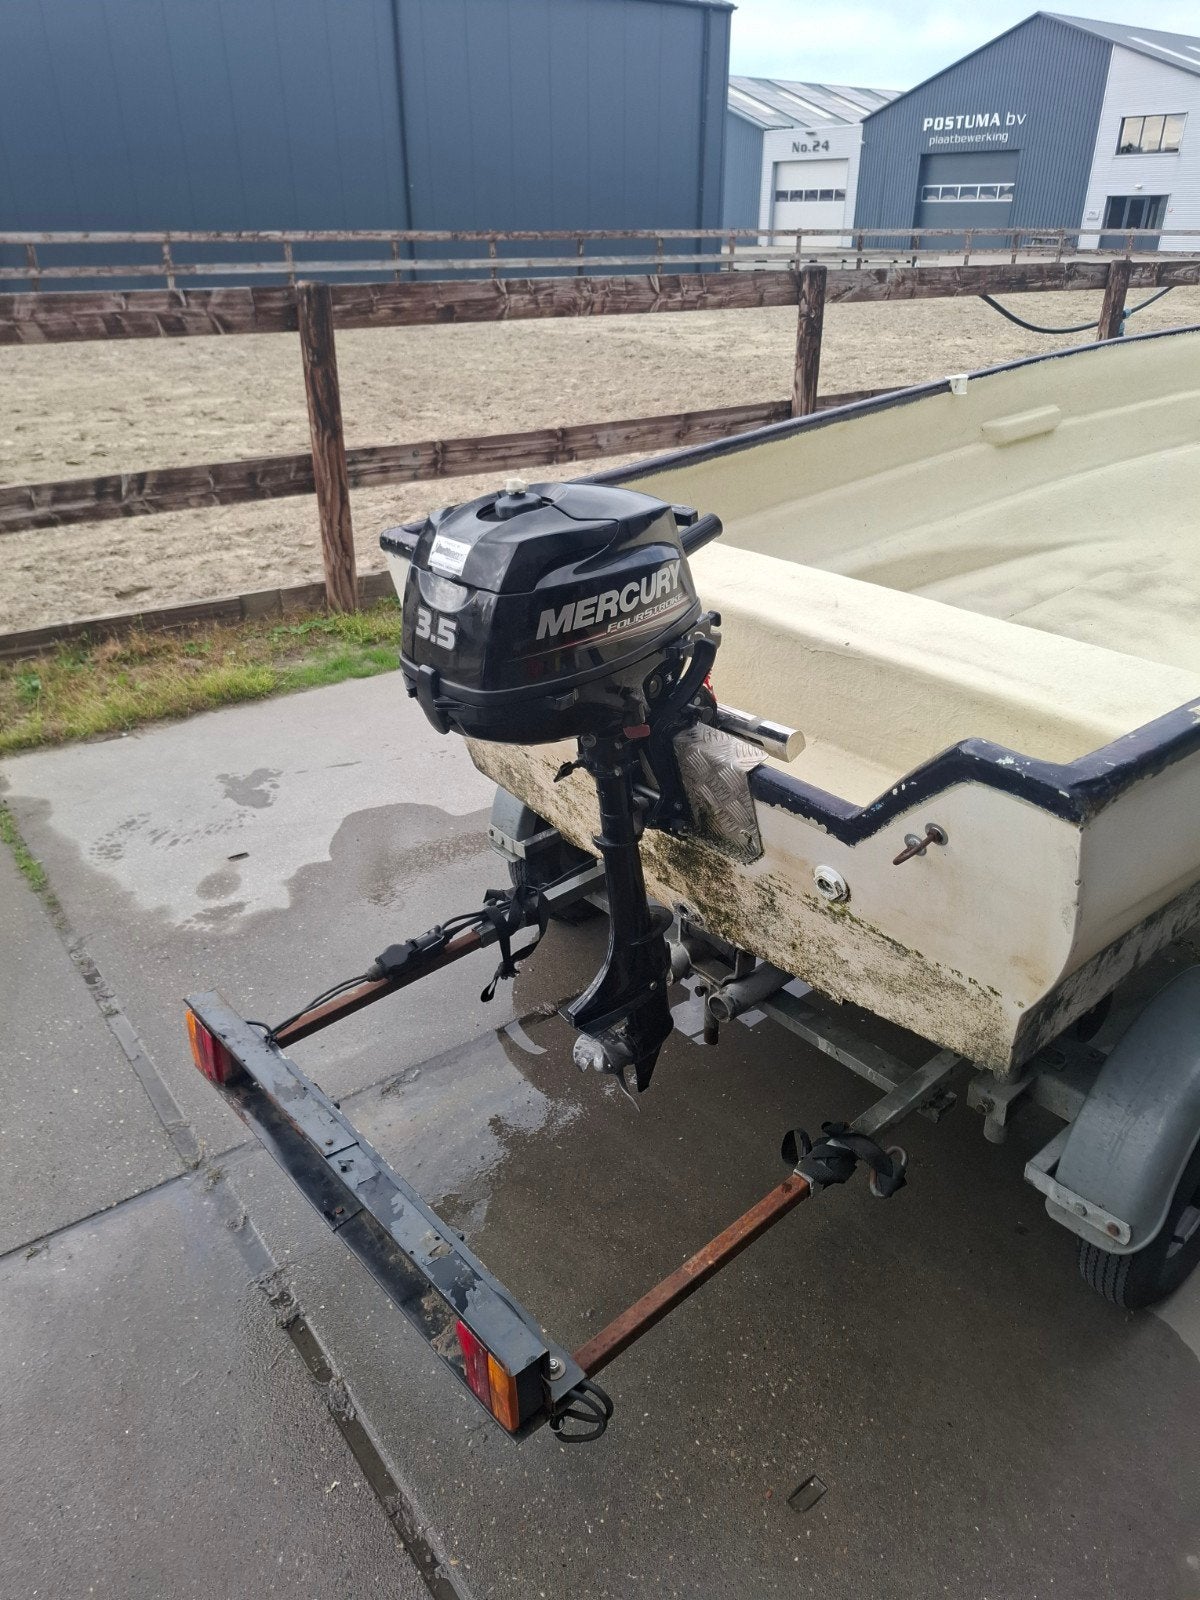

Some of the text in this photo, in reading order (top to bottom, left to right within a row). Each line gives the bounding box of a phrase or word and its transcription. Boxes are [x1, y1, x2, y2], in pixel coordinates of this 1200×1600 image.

[923, 112, 1026, 131] POSTUMA bv
[791, 140, 830, 153] No.24
[928, 132, 1009, 147] plaatbewerking
[535, 560, 681, 641] MERCURY
[607, 593, 685, 634] FOURSTROKE
[415, 607, 457, 651] 3.5
